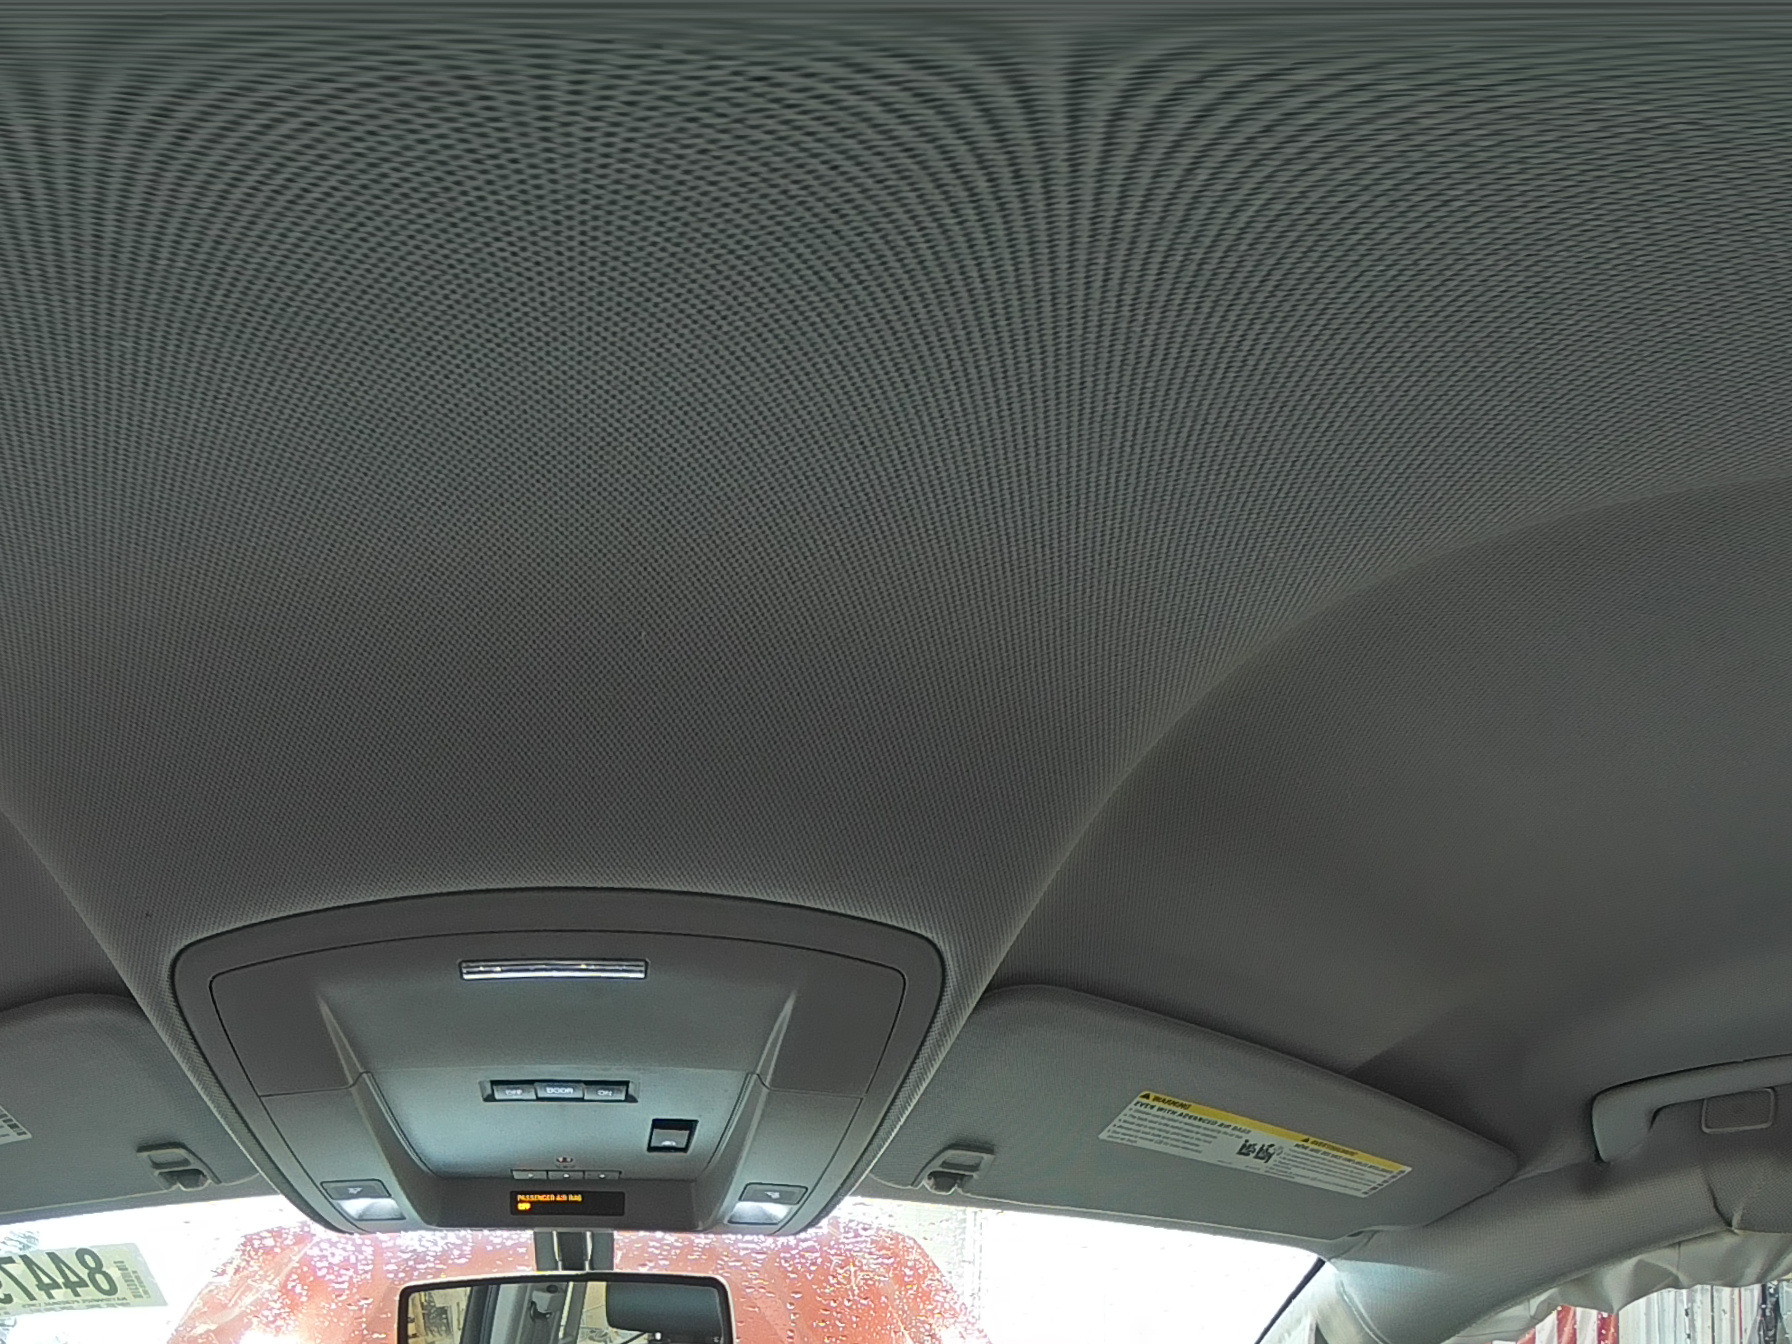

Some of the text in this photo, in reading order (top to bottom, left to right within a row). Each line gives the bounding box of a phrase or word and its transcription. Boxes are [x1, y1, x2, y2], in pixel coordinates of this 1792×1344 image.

[546, 1086, 574, 1094] DOOR
[1151, 1095, 1192, 1110] WARNING
[517, 1194, 555, 1202] PASSENGER
